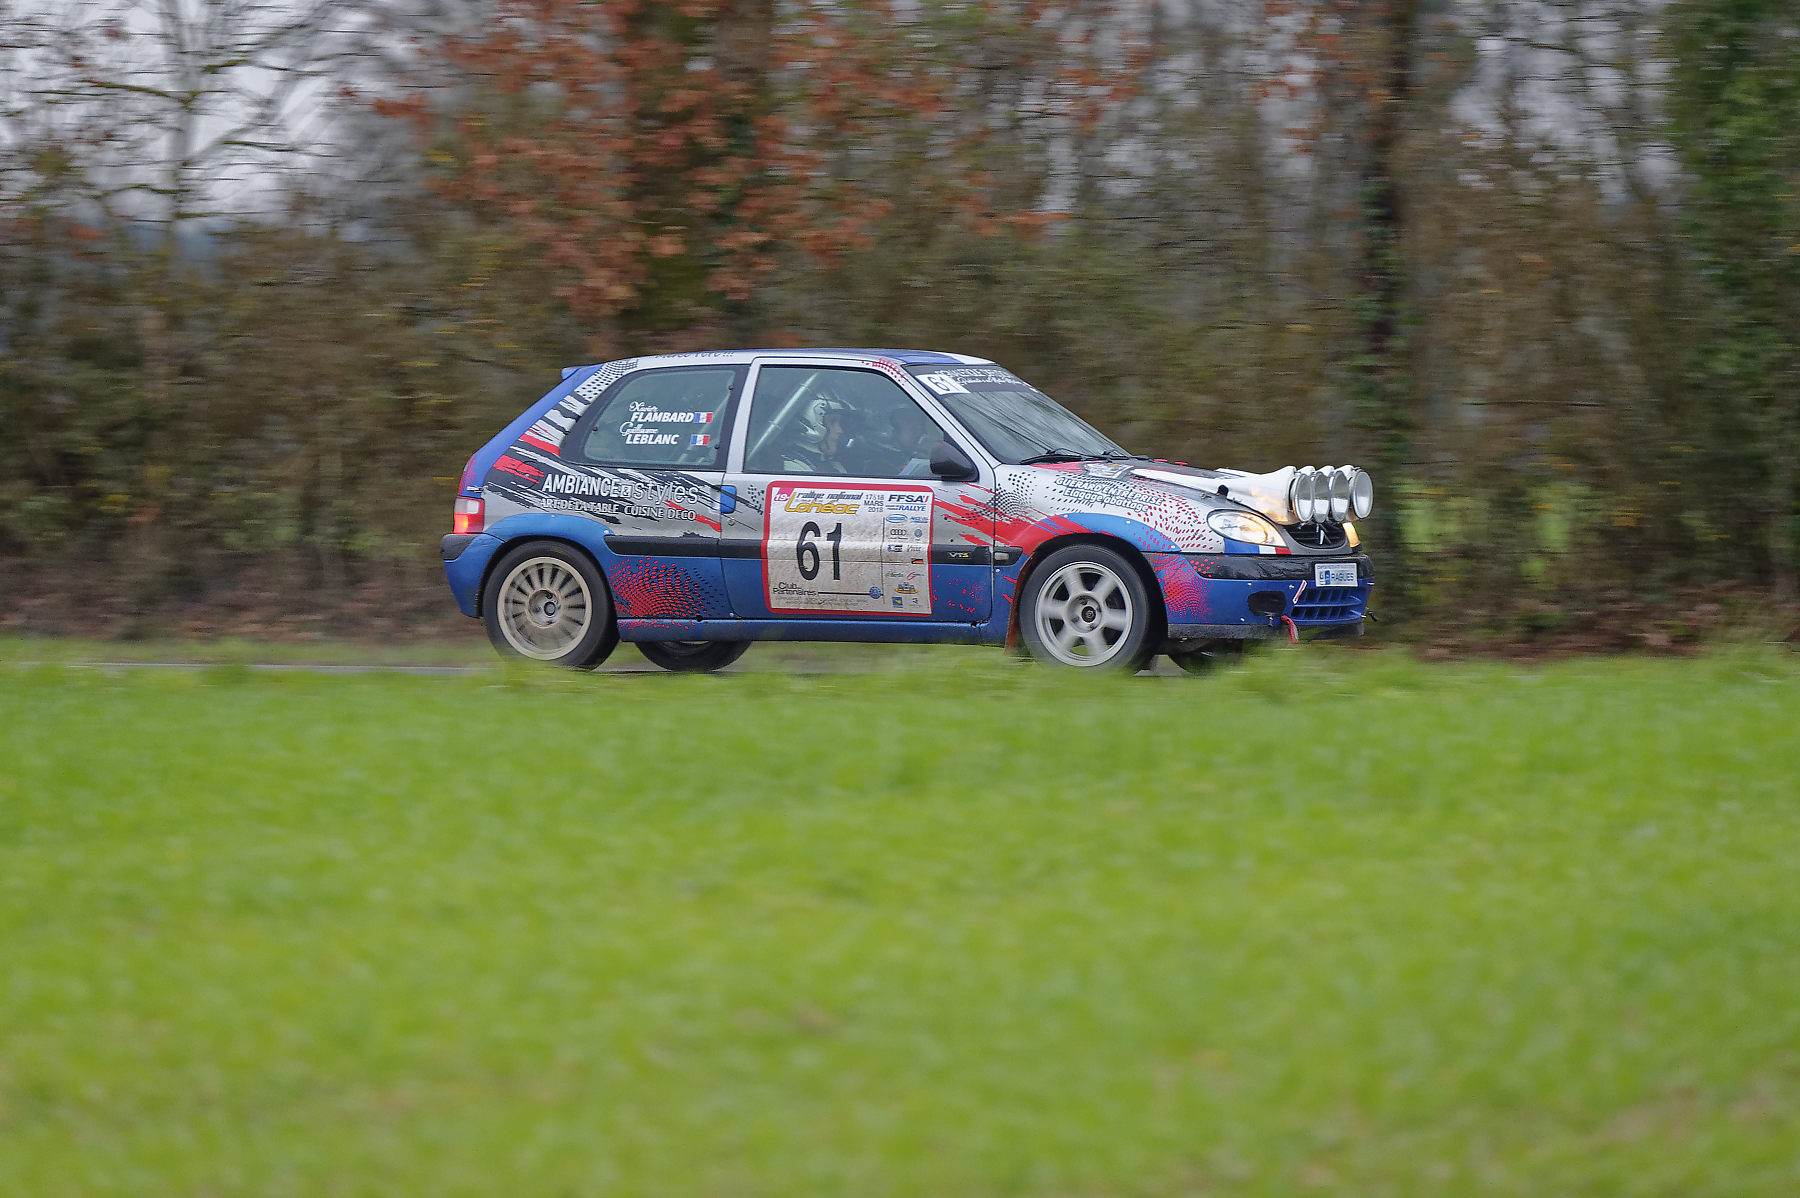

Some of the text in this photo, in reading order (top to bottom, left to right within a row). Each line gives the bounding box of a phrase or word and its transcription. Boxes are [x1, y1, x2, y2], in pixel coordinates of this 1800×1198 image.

[630, 412, 694, 423] FLAMBARD
[625, 434, 680, 445] LEBLANC
[542, 473, 620, 498] AMBIANCE
[633, 481, 699, 505] styles
[1102, 484, 1164, 506] ENTREPRISE
[588, 502, 620, 514] TABLE
[624, 505, 664, 518] CUISINE
[1104, 495, 1150, 513] abattage
[797, 521, 842, 580] 61
[778, 582, 798, 590] Club
